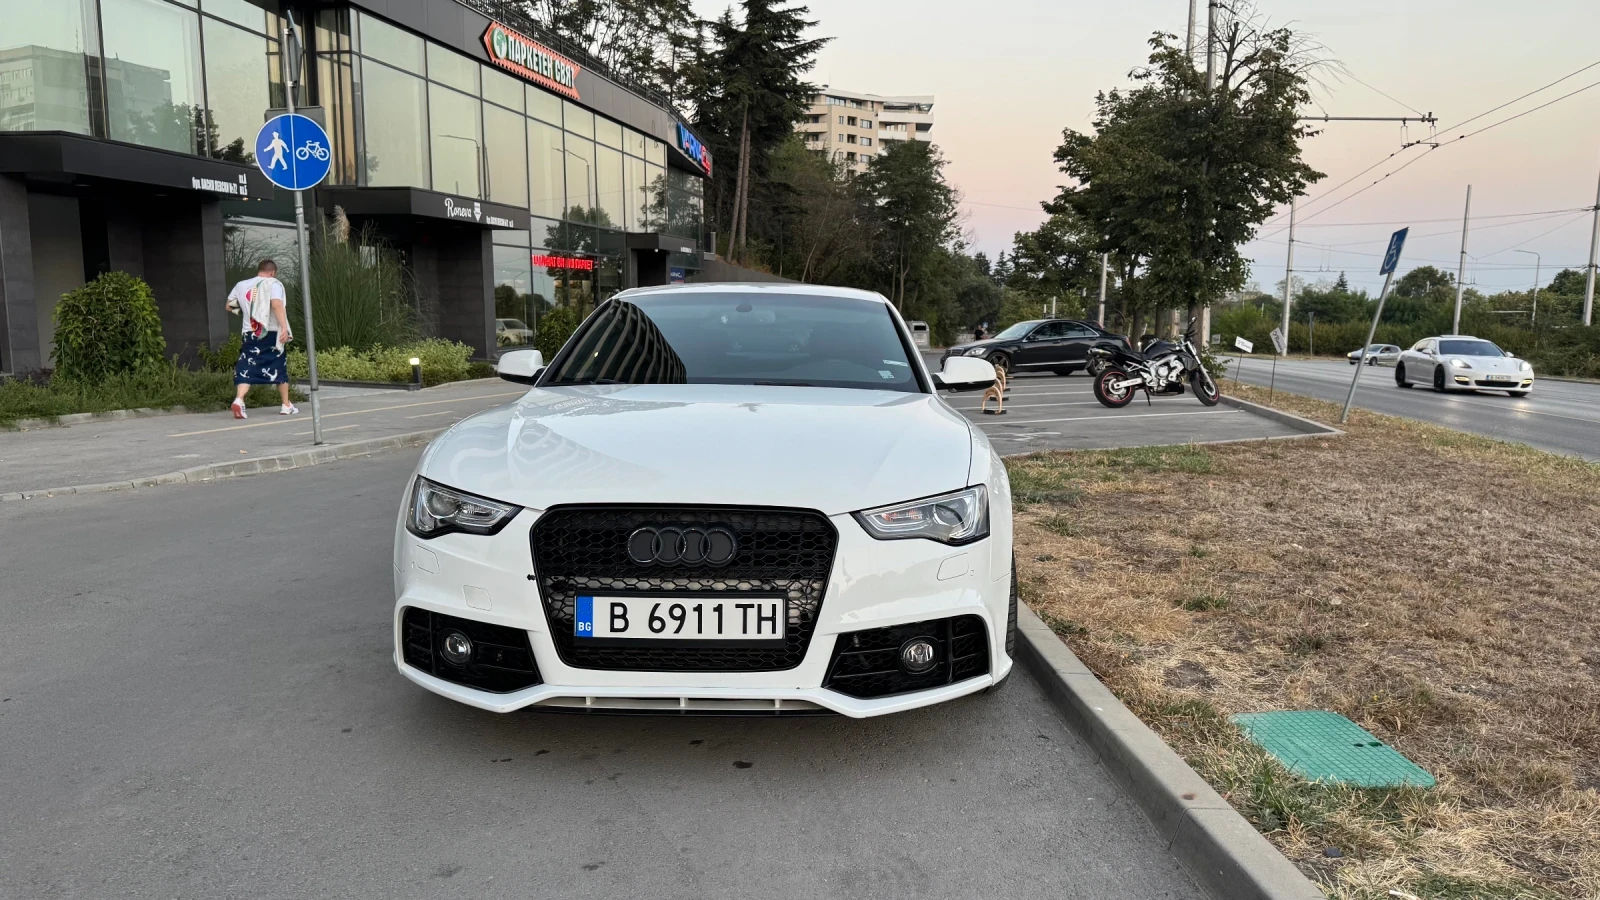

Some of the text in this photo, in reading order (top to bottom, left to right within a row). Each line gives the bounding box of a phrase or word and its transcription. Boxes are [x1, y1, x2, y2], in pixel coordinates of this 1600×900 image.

[508, 35, 575, 89] ПАРКЕТЕН СВЯТ
[444, 197, 472, 218] Roneva
[578, 622, 592, 631] BG
[609, 602, 777, 634] B 6911 TH
